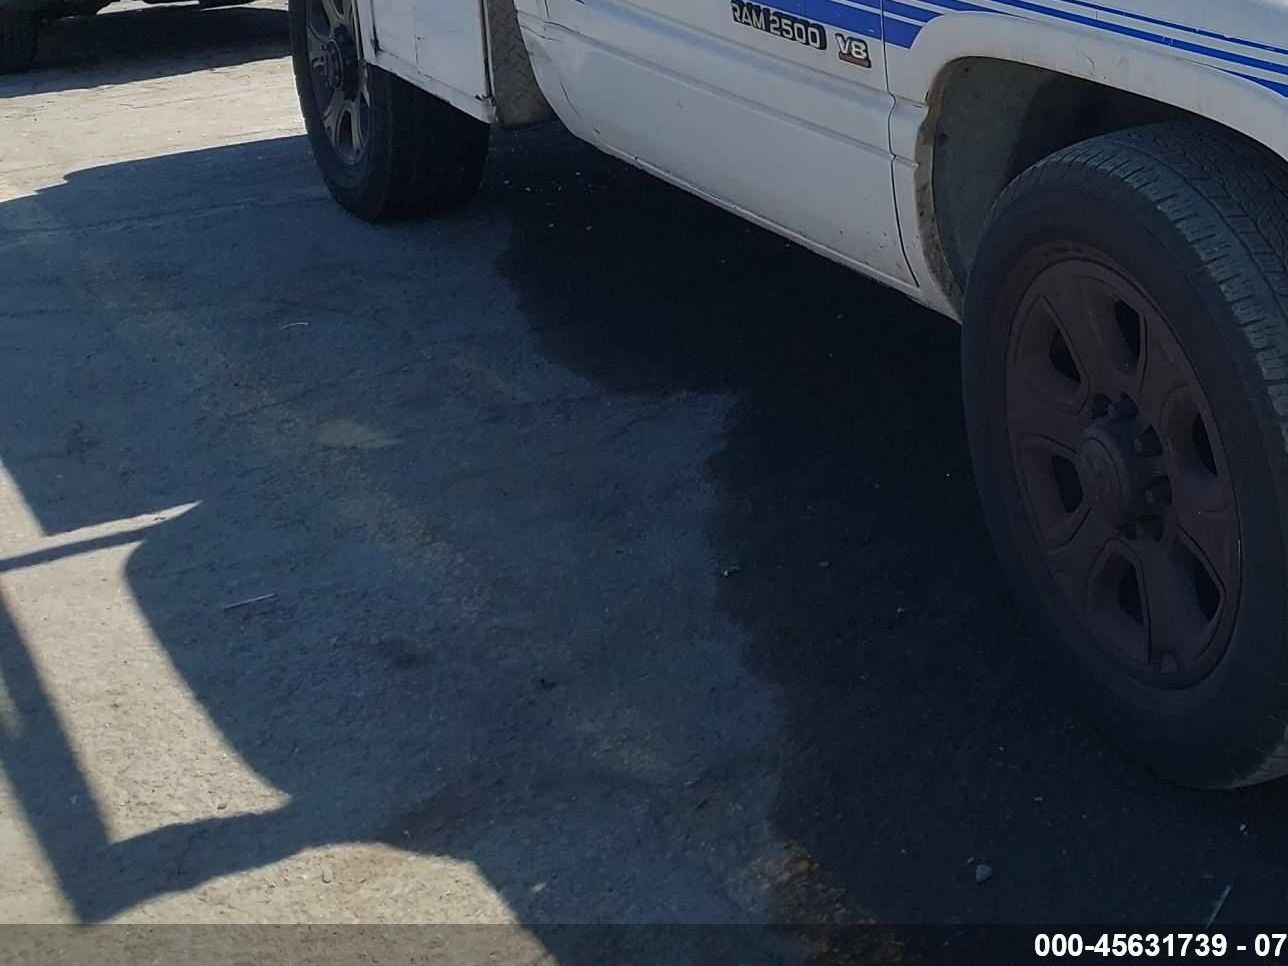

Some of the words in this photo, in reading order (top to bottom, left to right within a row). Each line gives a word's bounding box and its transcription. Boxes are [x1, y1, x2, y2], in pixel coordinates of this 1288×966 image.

[731, 0, 768, 32] RAM
[769, 11, 827, 50] 2500
[835, 33, 868, 59] V8
